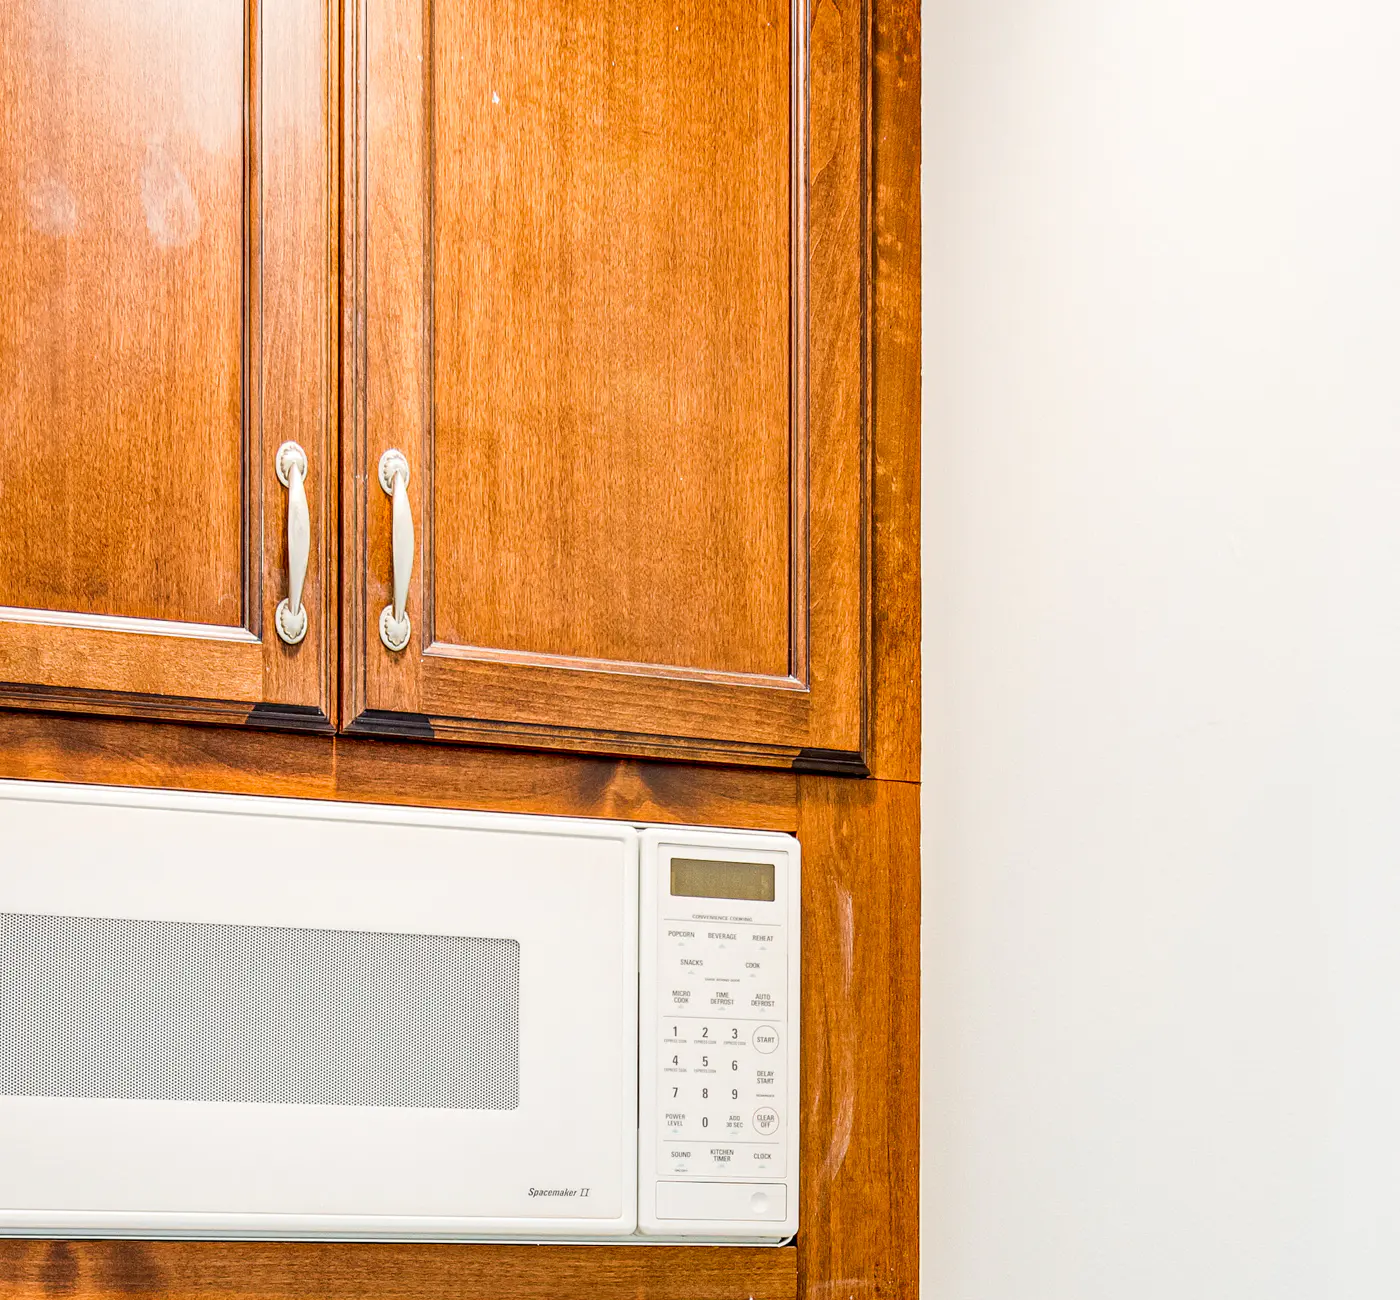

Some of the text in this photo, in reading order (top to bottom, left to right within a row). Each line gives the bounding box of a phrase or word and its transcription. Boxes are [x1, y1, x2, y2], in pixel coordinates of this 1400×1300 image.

[668, 930, 695, 938] POPCORN
[708, 932, 737, 940] BEVERAGE
[752, 934, 773, 942] REHEAT
[673, 1026, 678, 1037] 1
[702, 1027, 709, 1038] 2
[731, 1028, 738, 1039] 3
[672, 1055, 678, 1065] 4
[702, 1056, 709, 1067] 5
[731, 1060, 738, 1071] 6
[672, 1087, 678, 1098] 7
[702, 1088, 709, 1099] 8
[731, 1088, 738, 1099] 9
[702, 1116, 709, 1127] 0
[528, 1187, 577, 1198] Spacemaker
